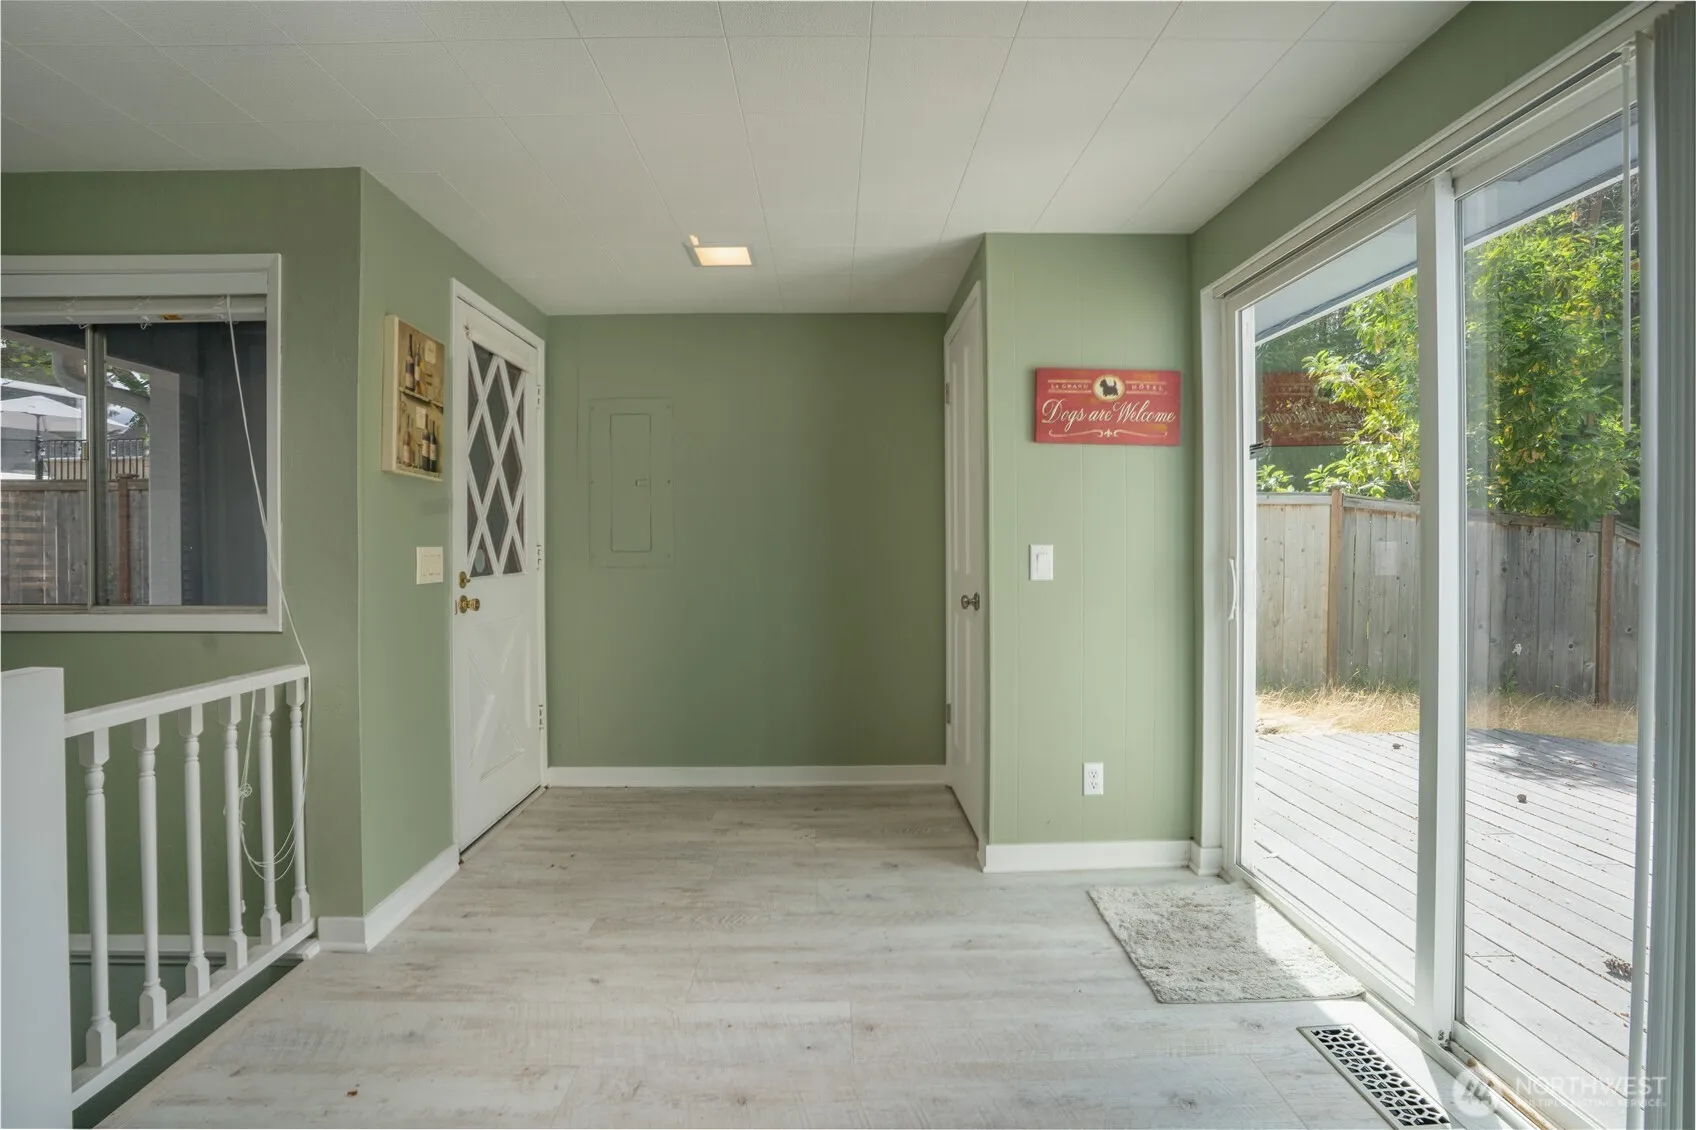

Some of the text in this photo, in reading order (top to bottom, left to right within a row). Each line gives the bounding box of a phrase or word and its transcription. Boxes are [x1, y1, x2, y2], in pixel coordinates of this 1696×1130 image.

[1041, 398, 1176, 432] Dogs are Welcome
